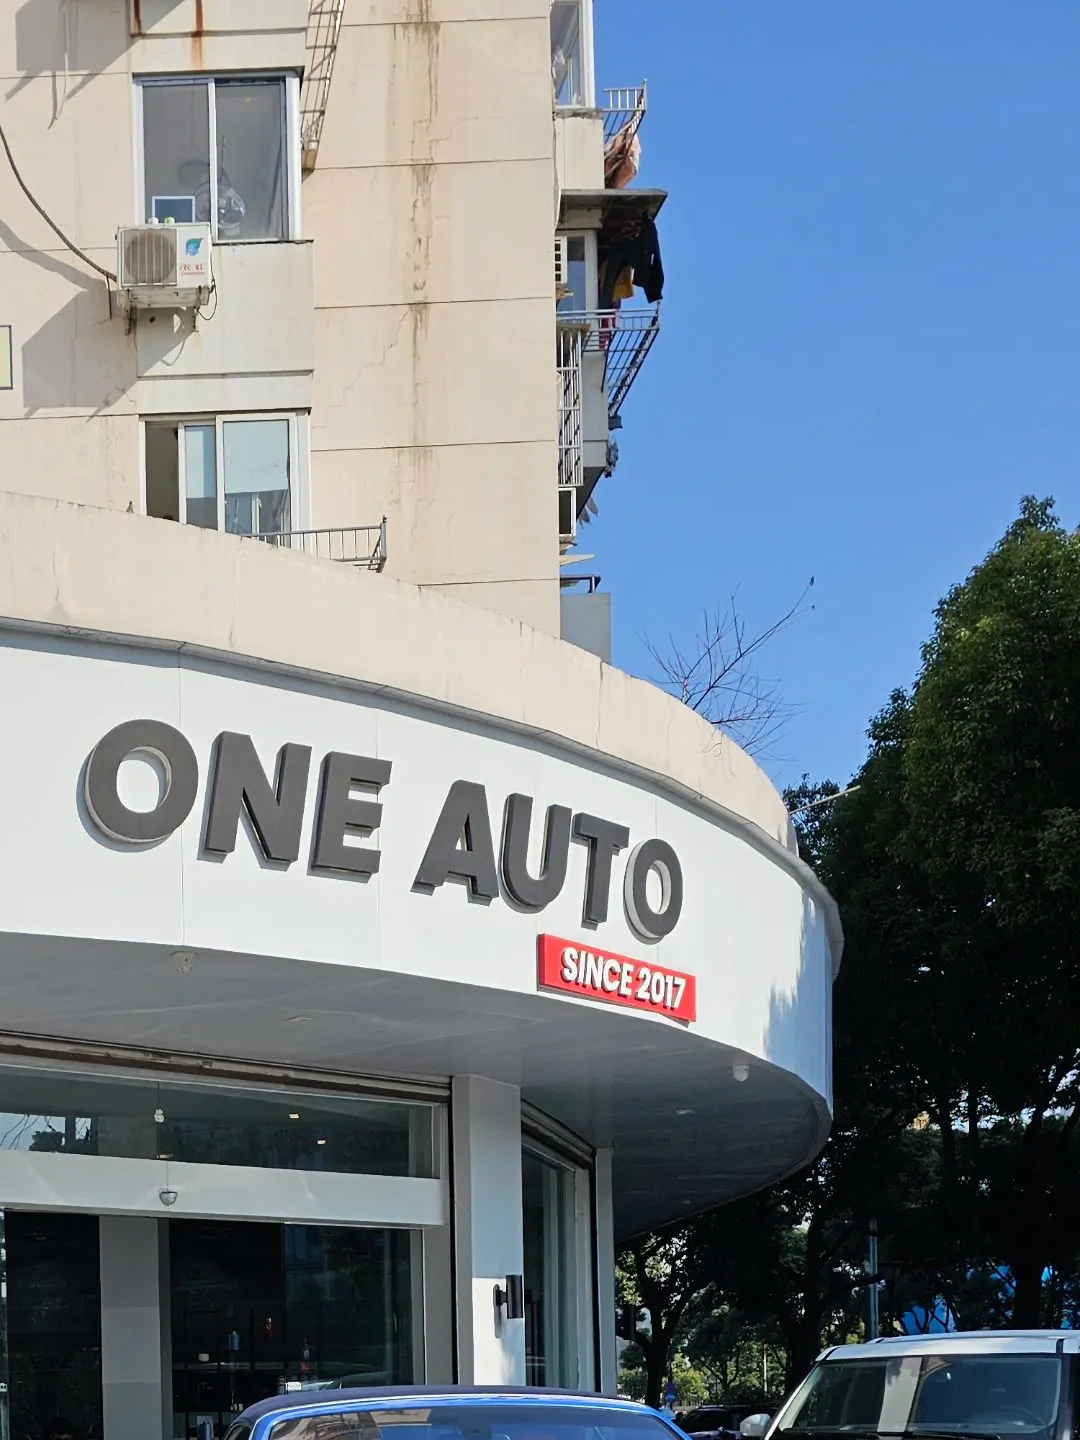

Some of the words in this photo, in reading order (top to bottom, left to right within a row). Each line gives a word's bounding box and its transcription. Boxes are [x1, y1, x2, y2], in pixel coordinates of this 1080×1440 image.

[84, 718, 393, 877] ONE
[411, 779, 684, 940] AUTO
[561, 946, 635, 997] SINCE
[635, 966, 687, 1010] 2017
